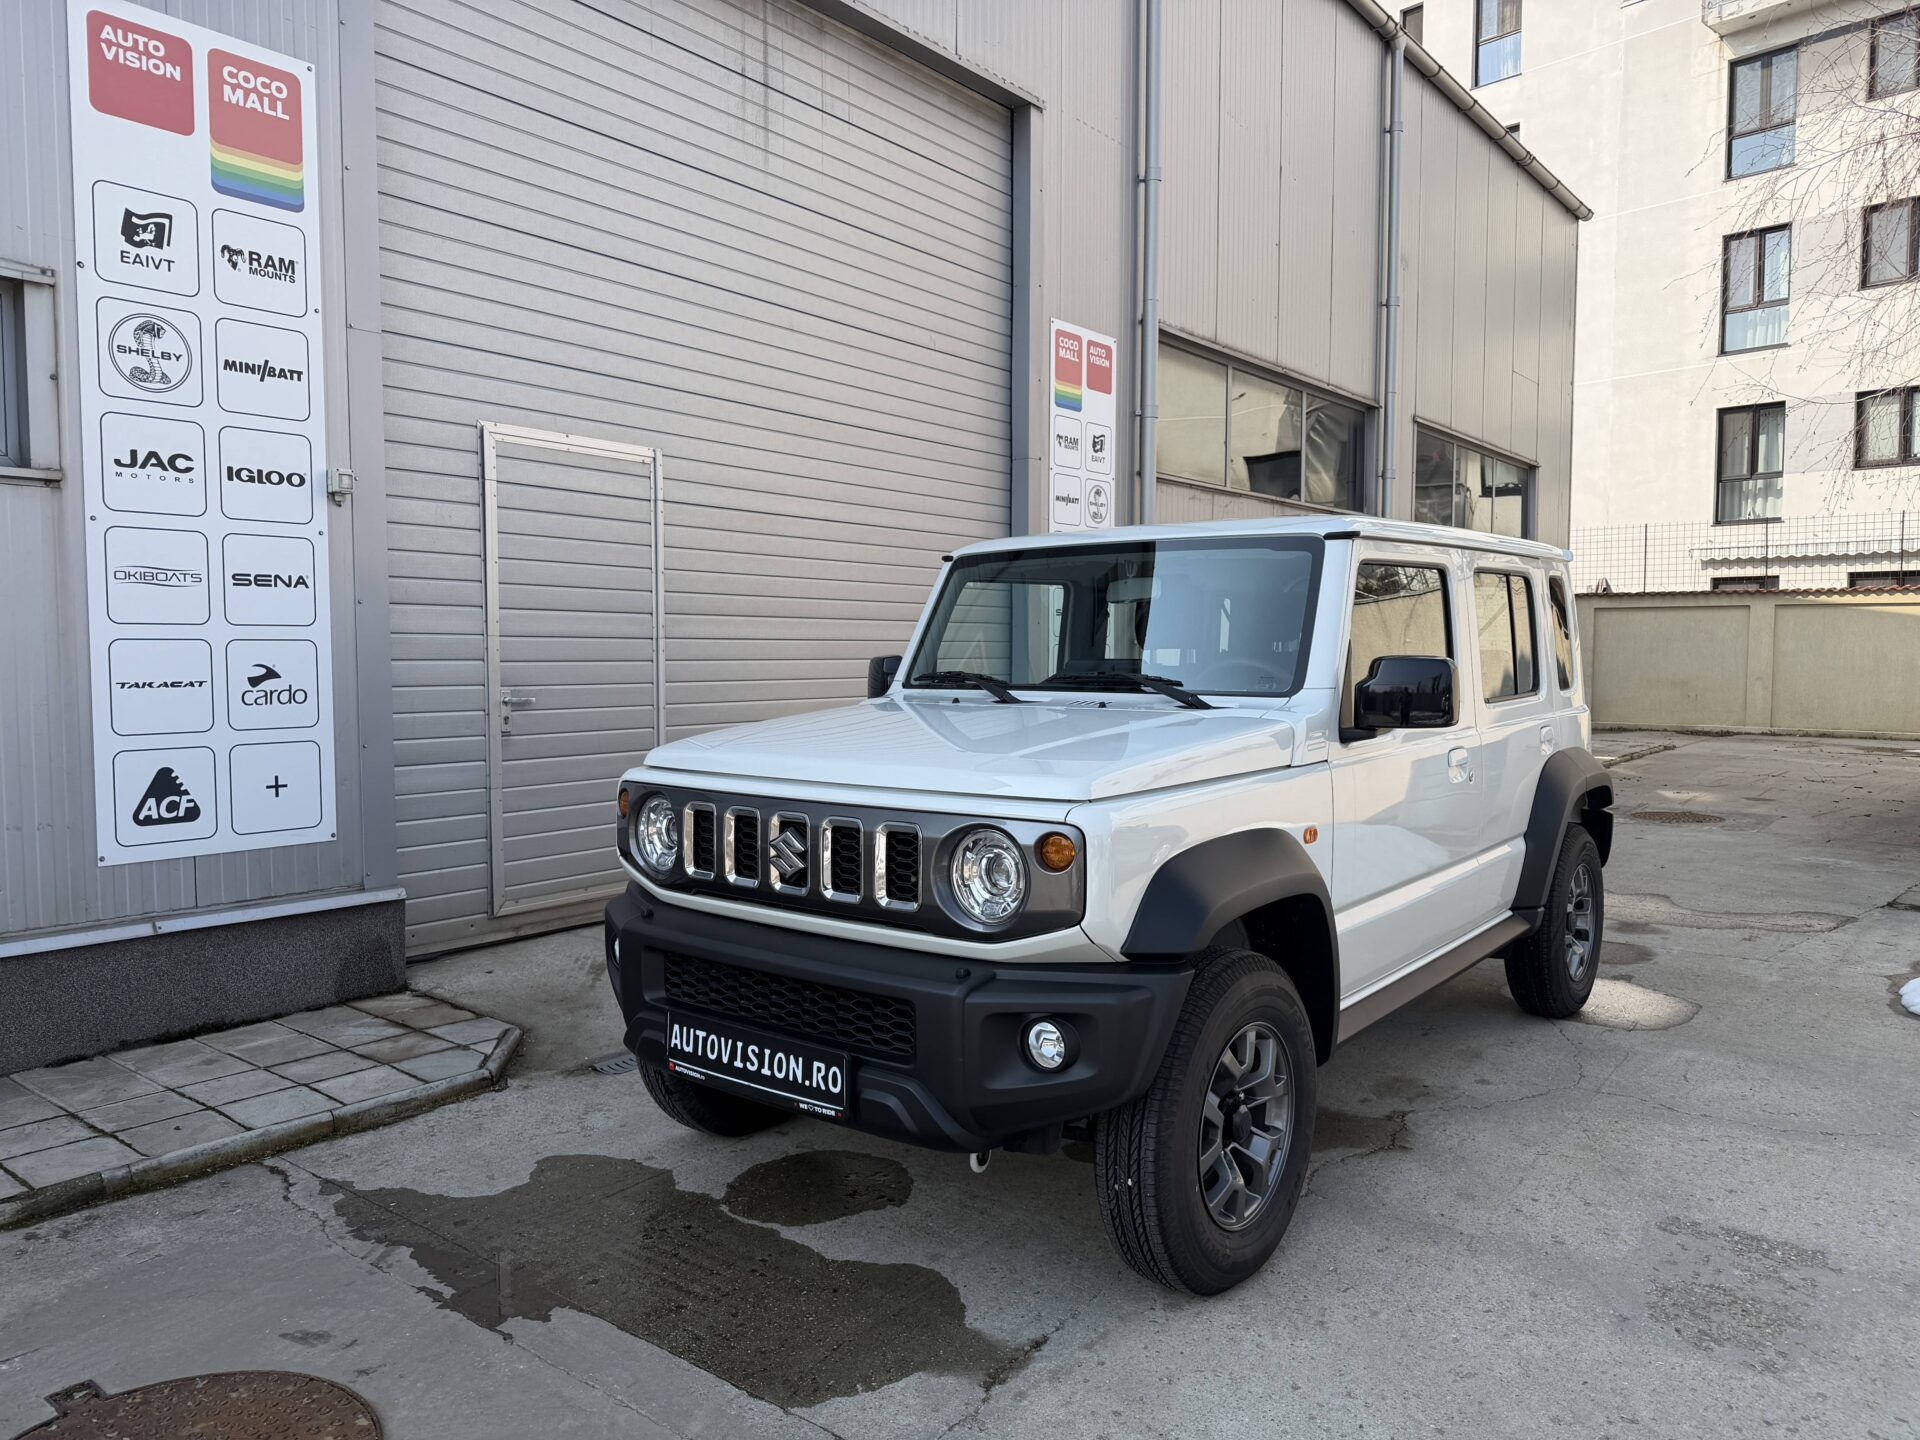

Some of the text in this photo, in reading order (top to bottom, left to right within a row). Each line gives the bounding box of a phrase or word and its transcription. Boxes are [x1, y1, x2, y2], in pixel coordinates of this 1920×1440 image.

[100, 25, 165, 57] AUTO
[101, 43, 182, 82] VISION
[222, 65, 289, 99] COCO
[222, 84, 291, 121] MALL
[120, 250, 176, 273] EAIVT
[248, 250, 297, 276] RAM
[248, 266, 297, 284] MOUNTS
[116, 344, 184, 363] SHELBY
[1059, 337, 1079, 351] COCO
[1089, 345, 1106, 358] AUTO
[1059, 347, 1079, 362] MALL
[1090, 354, 1109, 368] VISION
[1064, 435, 1079, 447] RAM
[113, 448, 195, 474] JAC
[1091, 454, 1105, 464] EAIVT
[115, 470, 195, 484] MOTORS
[226, 466, 306, 488] IGLOO
[113, 570, 203, 584] OKIBOATS
[231, 573, 310, 589] SENA
[241, 684, 308, 706] cardo
[138, 795, 195, 820] ACF
[670, 1023, 842, 1094] AUTOVISION.RO
[799, 1102, 808, 1110] WE
[822, 1108, 836, 1117] RIDE
